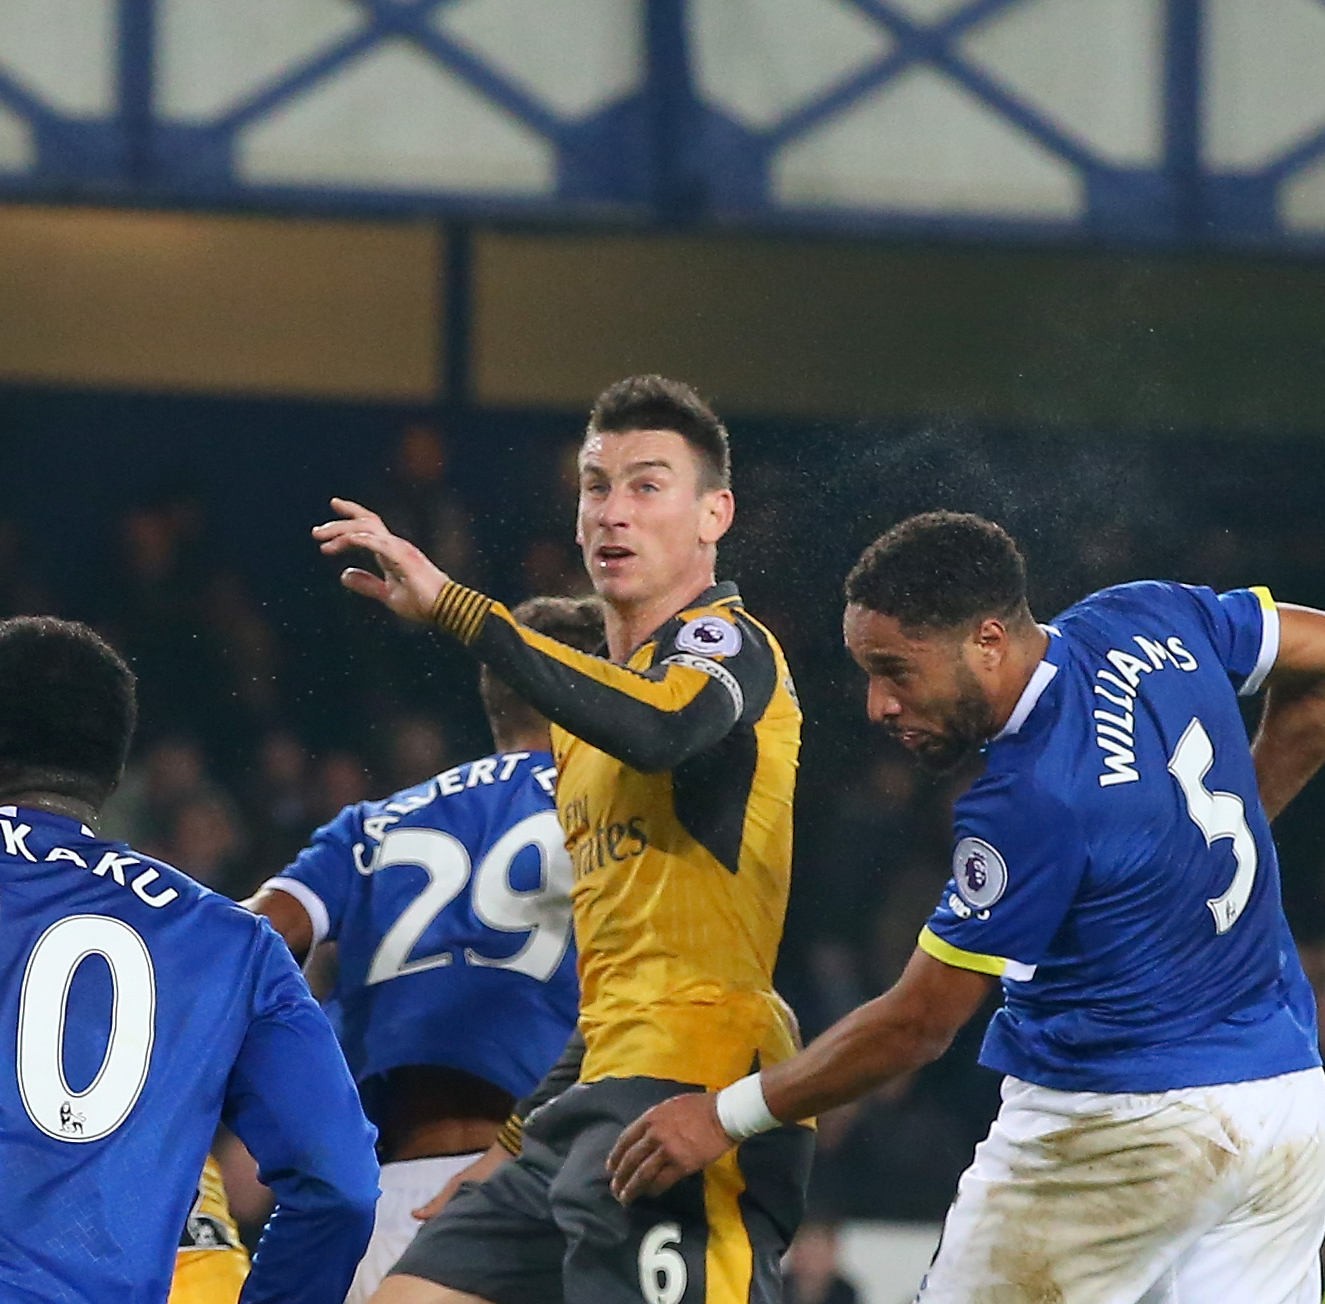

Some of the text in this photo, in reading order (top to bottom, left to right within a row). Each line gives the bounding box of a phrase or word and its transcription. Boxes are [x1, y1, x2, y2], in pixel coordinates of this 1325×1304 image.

[1093, 635, 1199, 787] WILLIAMS
[366, 809, 574, 986] 29
[1168, 716, 1258, 935] 5
